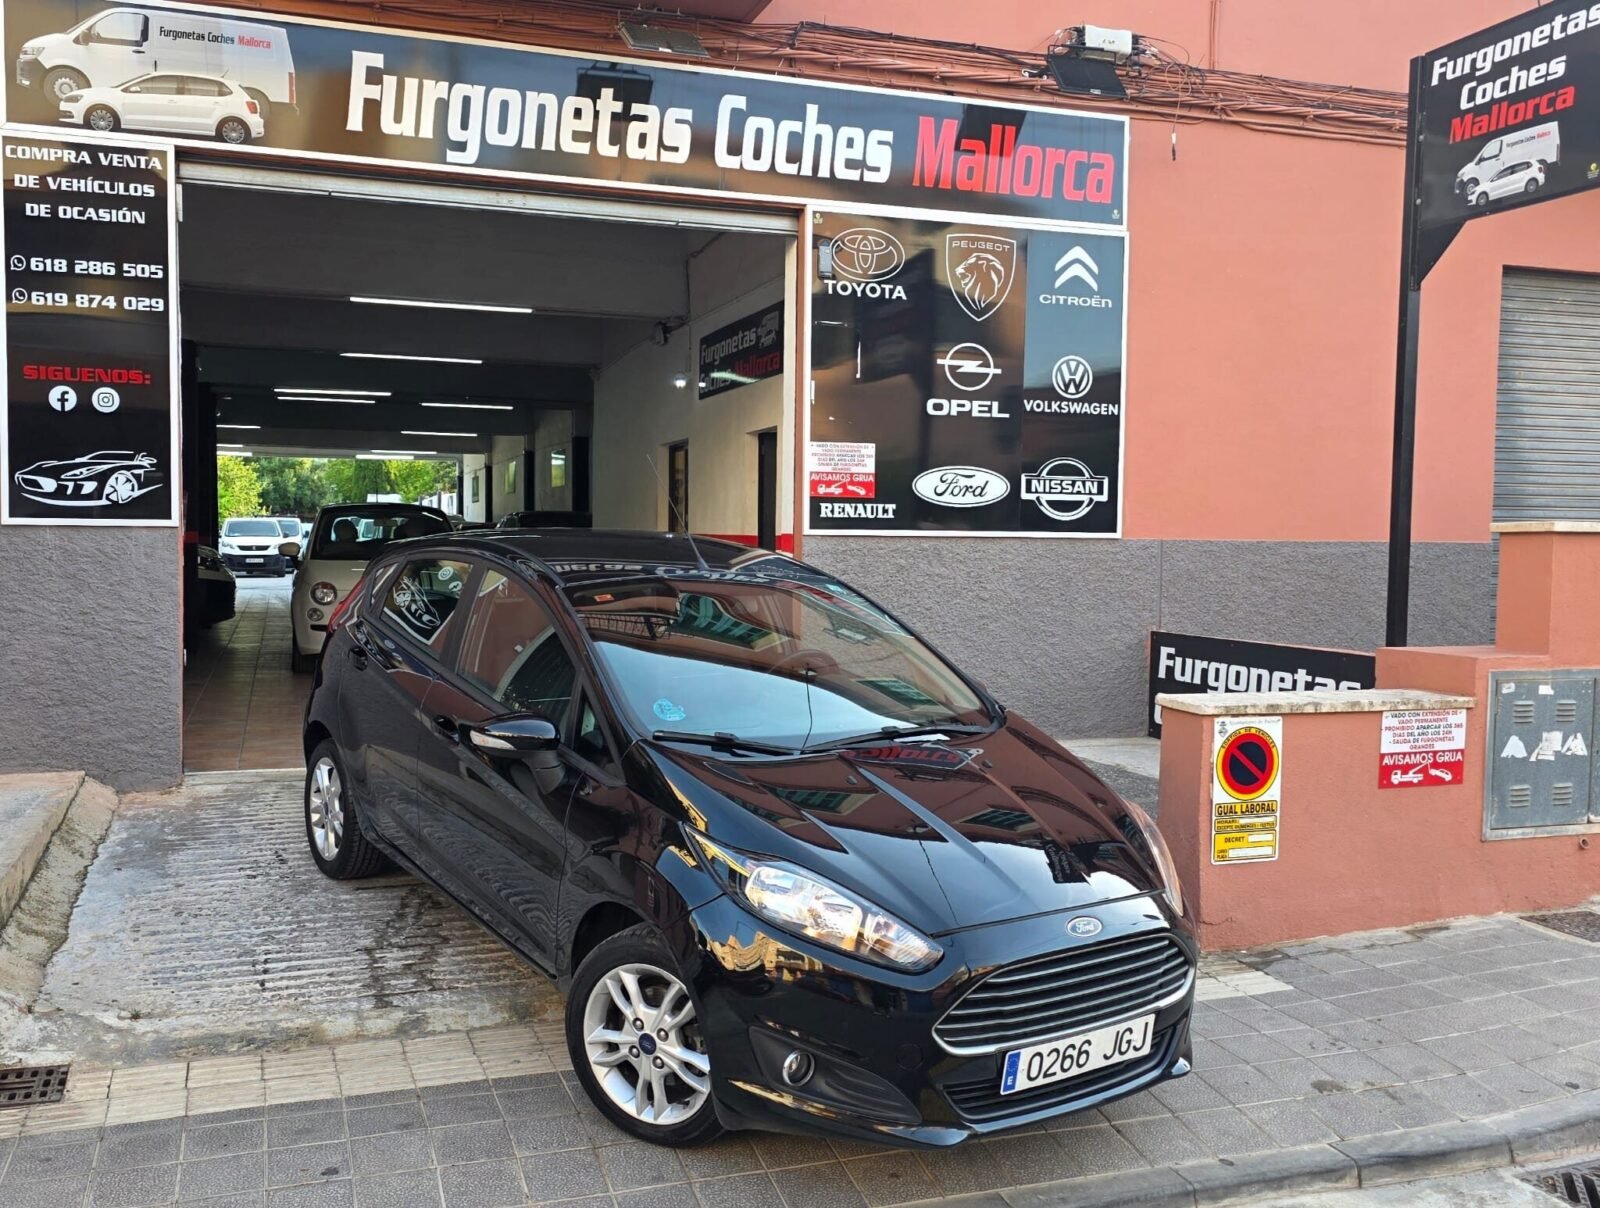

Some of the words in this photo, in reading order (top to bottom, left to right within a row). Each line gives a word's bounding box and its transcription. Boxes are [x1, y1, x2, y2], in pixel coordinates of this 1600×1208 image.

[159, 26, 205, 41] Furgonetas
[207, 32, 235, 45] Coches
[237, 35, 271, 49] Mallorca
[1431, 3, 1600, 87] Furgonetas
[1460, 55, 1567, 111] Coches
[1449, 85, 1576, 144] Mallorca
[345, 50, 693, 165] Furgonetas
[714, 94, 894, 184] Coches
[912, 116, 1115, 204] Mallorca
[5, 145, 92, 165] COMPRA
[98, 152, 162, 170] VENTA
[14, 173, 40, 189] DE
[46, 175, 156, 198] VEHÍCULOS
[25, 203, 51, 218] DE
[58, 205, 146, 225] OCASIÓN
[952, 240, 1010, 252] PEUGEOT
[30, 257, 68, 273] 618
[75, 260, 116, 276] 286
[123, 263, 164, 279] 505
[823, 279, 907, 300] TOYOTA
[31, 291, 68, 307] 619
[75, 294, 117, 309] 874
[123, 296, 165, 312] 029
[22, 364, 152, 385] SIGUENOS:
[926, 399, 1010, 418] OPEL
[1023, 399, 1119, 416] VOLKSWAGEN
[811, 473, 851, 482] AVISAMOS
[852, 474, 874, 482] GRUA
[934, 472, 988, 498] Ford
[1030, 478, 1098, 494] NISSAN
[819, 503, 897, 519] RENAULT
[1382, 753, 1434, 766] AVISAMOS
[1435, 751, 1463, 763] GRUA
[1217, 804, 1238, 816] GUAL
[1240, 802, 1275, 814] LABORAL
[1026, 1039, 1092, 1082] 0266
[1103, 1021, 1149, 1061] JGJ
[1007, 1076, 1014, 1085] E
